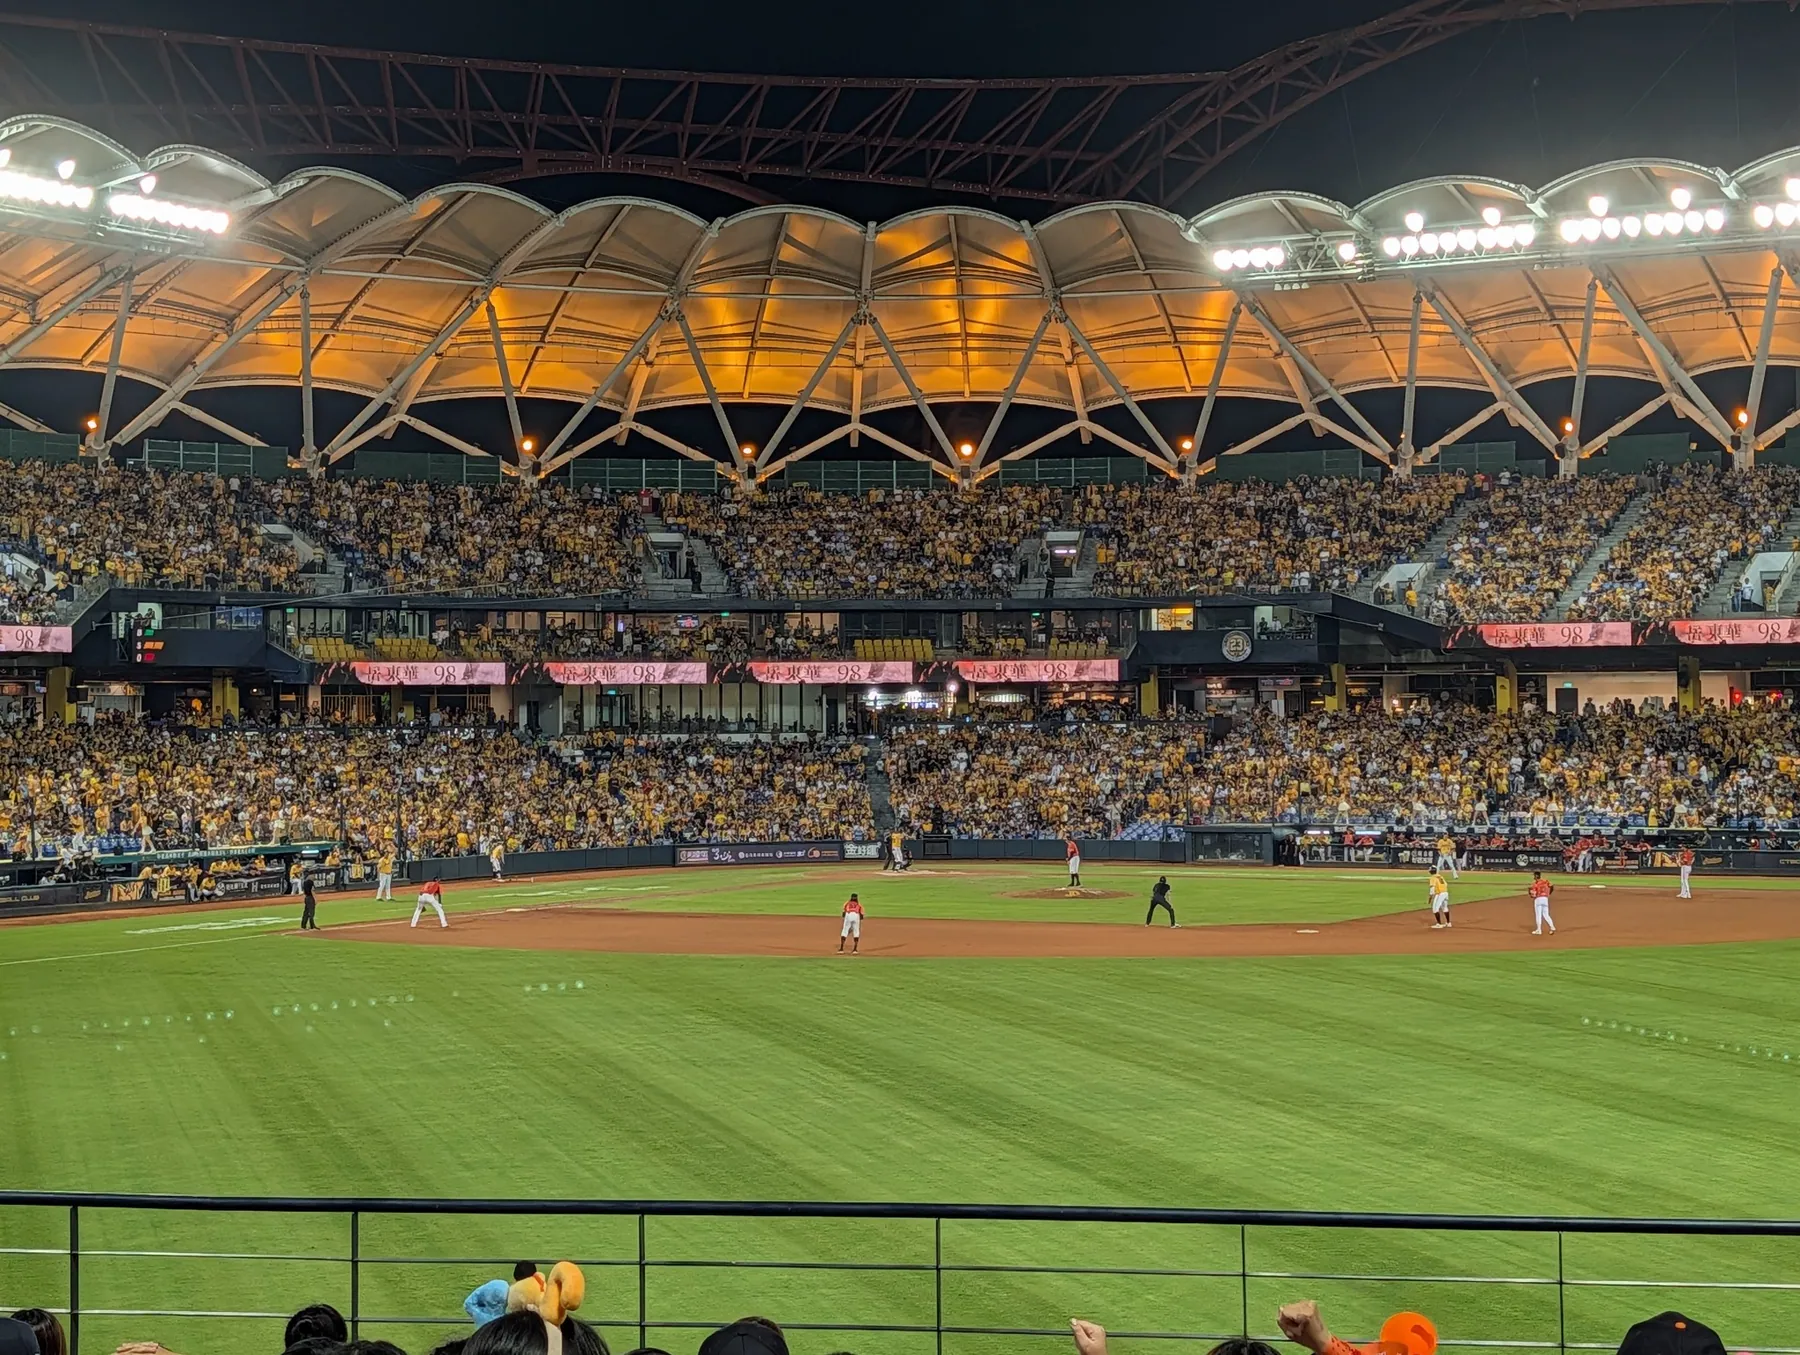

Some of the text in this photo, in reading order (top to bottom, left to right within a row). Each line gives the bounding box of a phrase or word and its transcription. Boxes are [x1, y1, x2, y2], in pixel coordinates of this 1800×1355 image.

[15, 629, 34, 649] 98
[1561, 626, 1583, 644] 98
[1758, 622, 1781, 641] 98
[136, 641, 142, 650] S
[1230, 639, 1243, 651] 23
[434, 665, 456, 683] 98
[633, 665, 656, 682] 98
[837, 665, 862, 681] 98
[1044, 663, 1067, 680] 98
